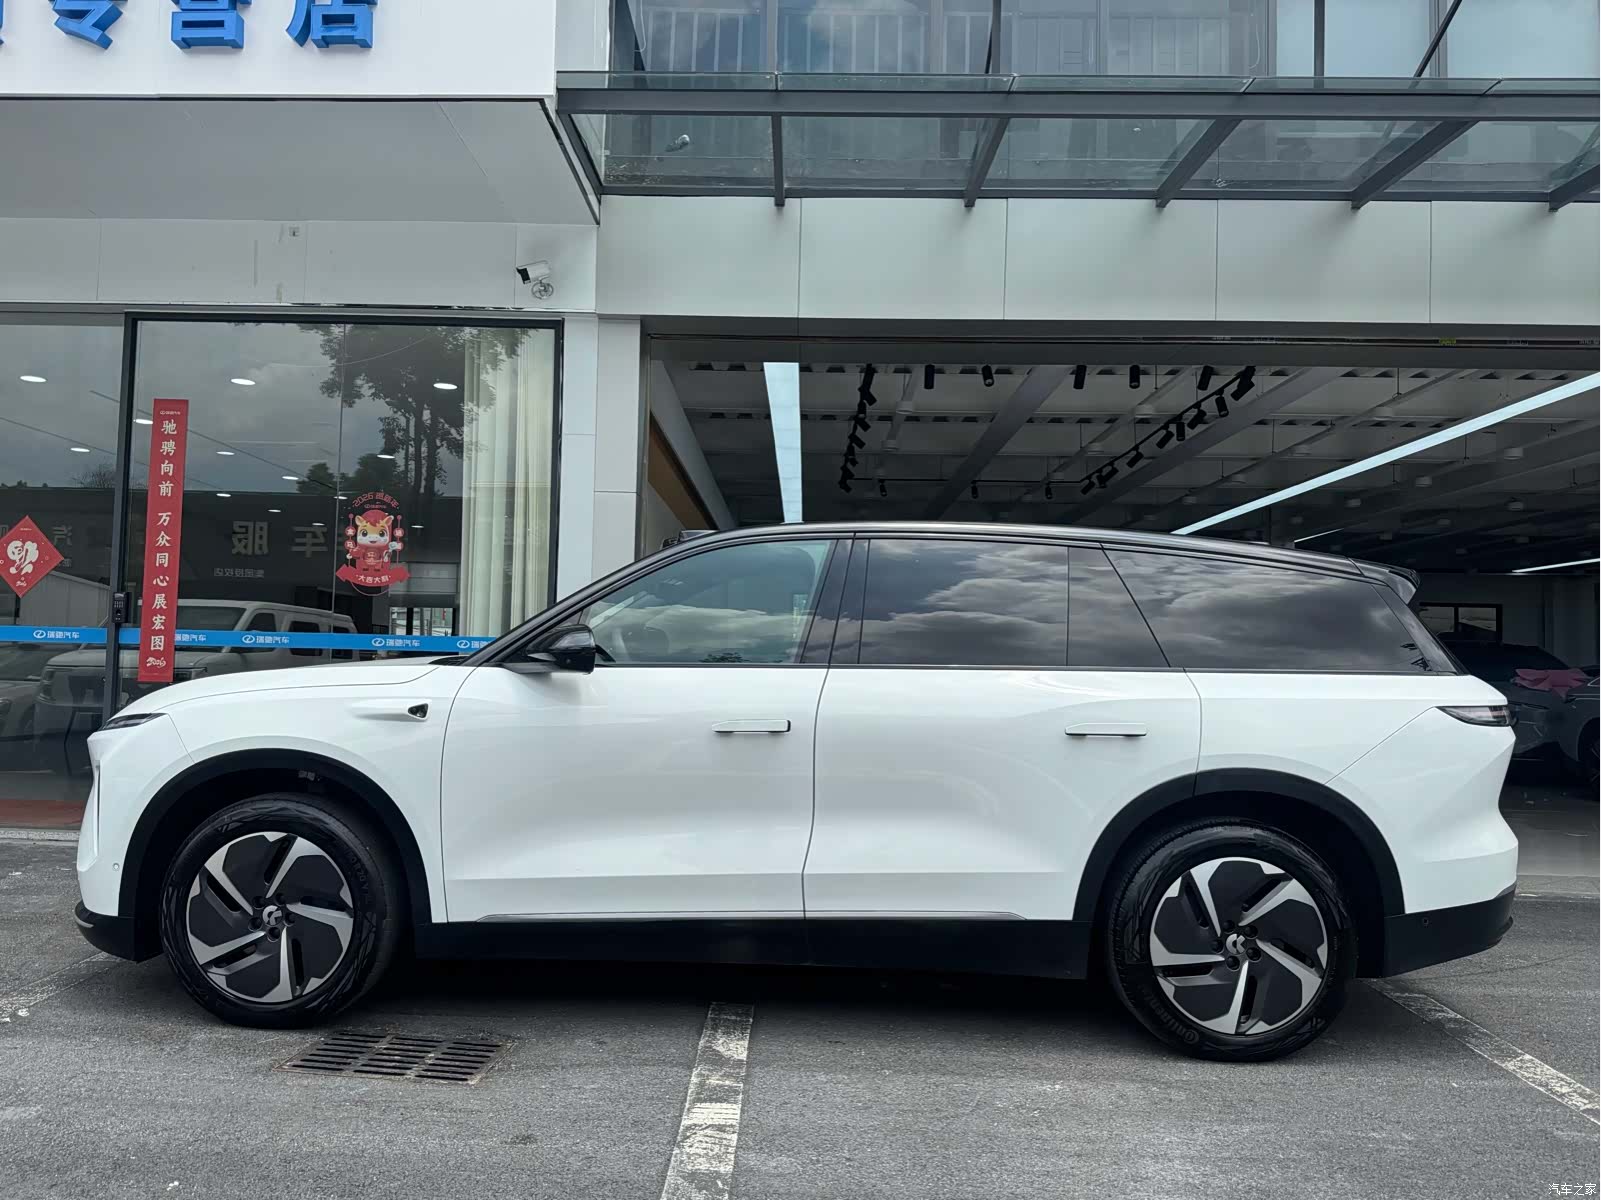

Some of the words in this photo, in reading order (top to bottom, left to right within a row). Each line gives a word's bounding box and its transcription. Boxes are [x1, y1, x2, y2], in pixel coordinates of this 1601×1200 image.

[158, 419, 177, 497] 驰骋向前
[352, 491, 374, 508] 2026
[150, 511, 172, 651] 万众同心展宏图
